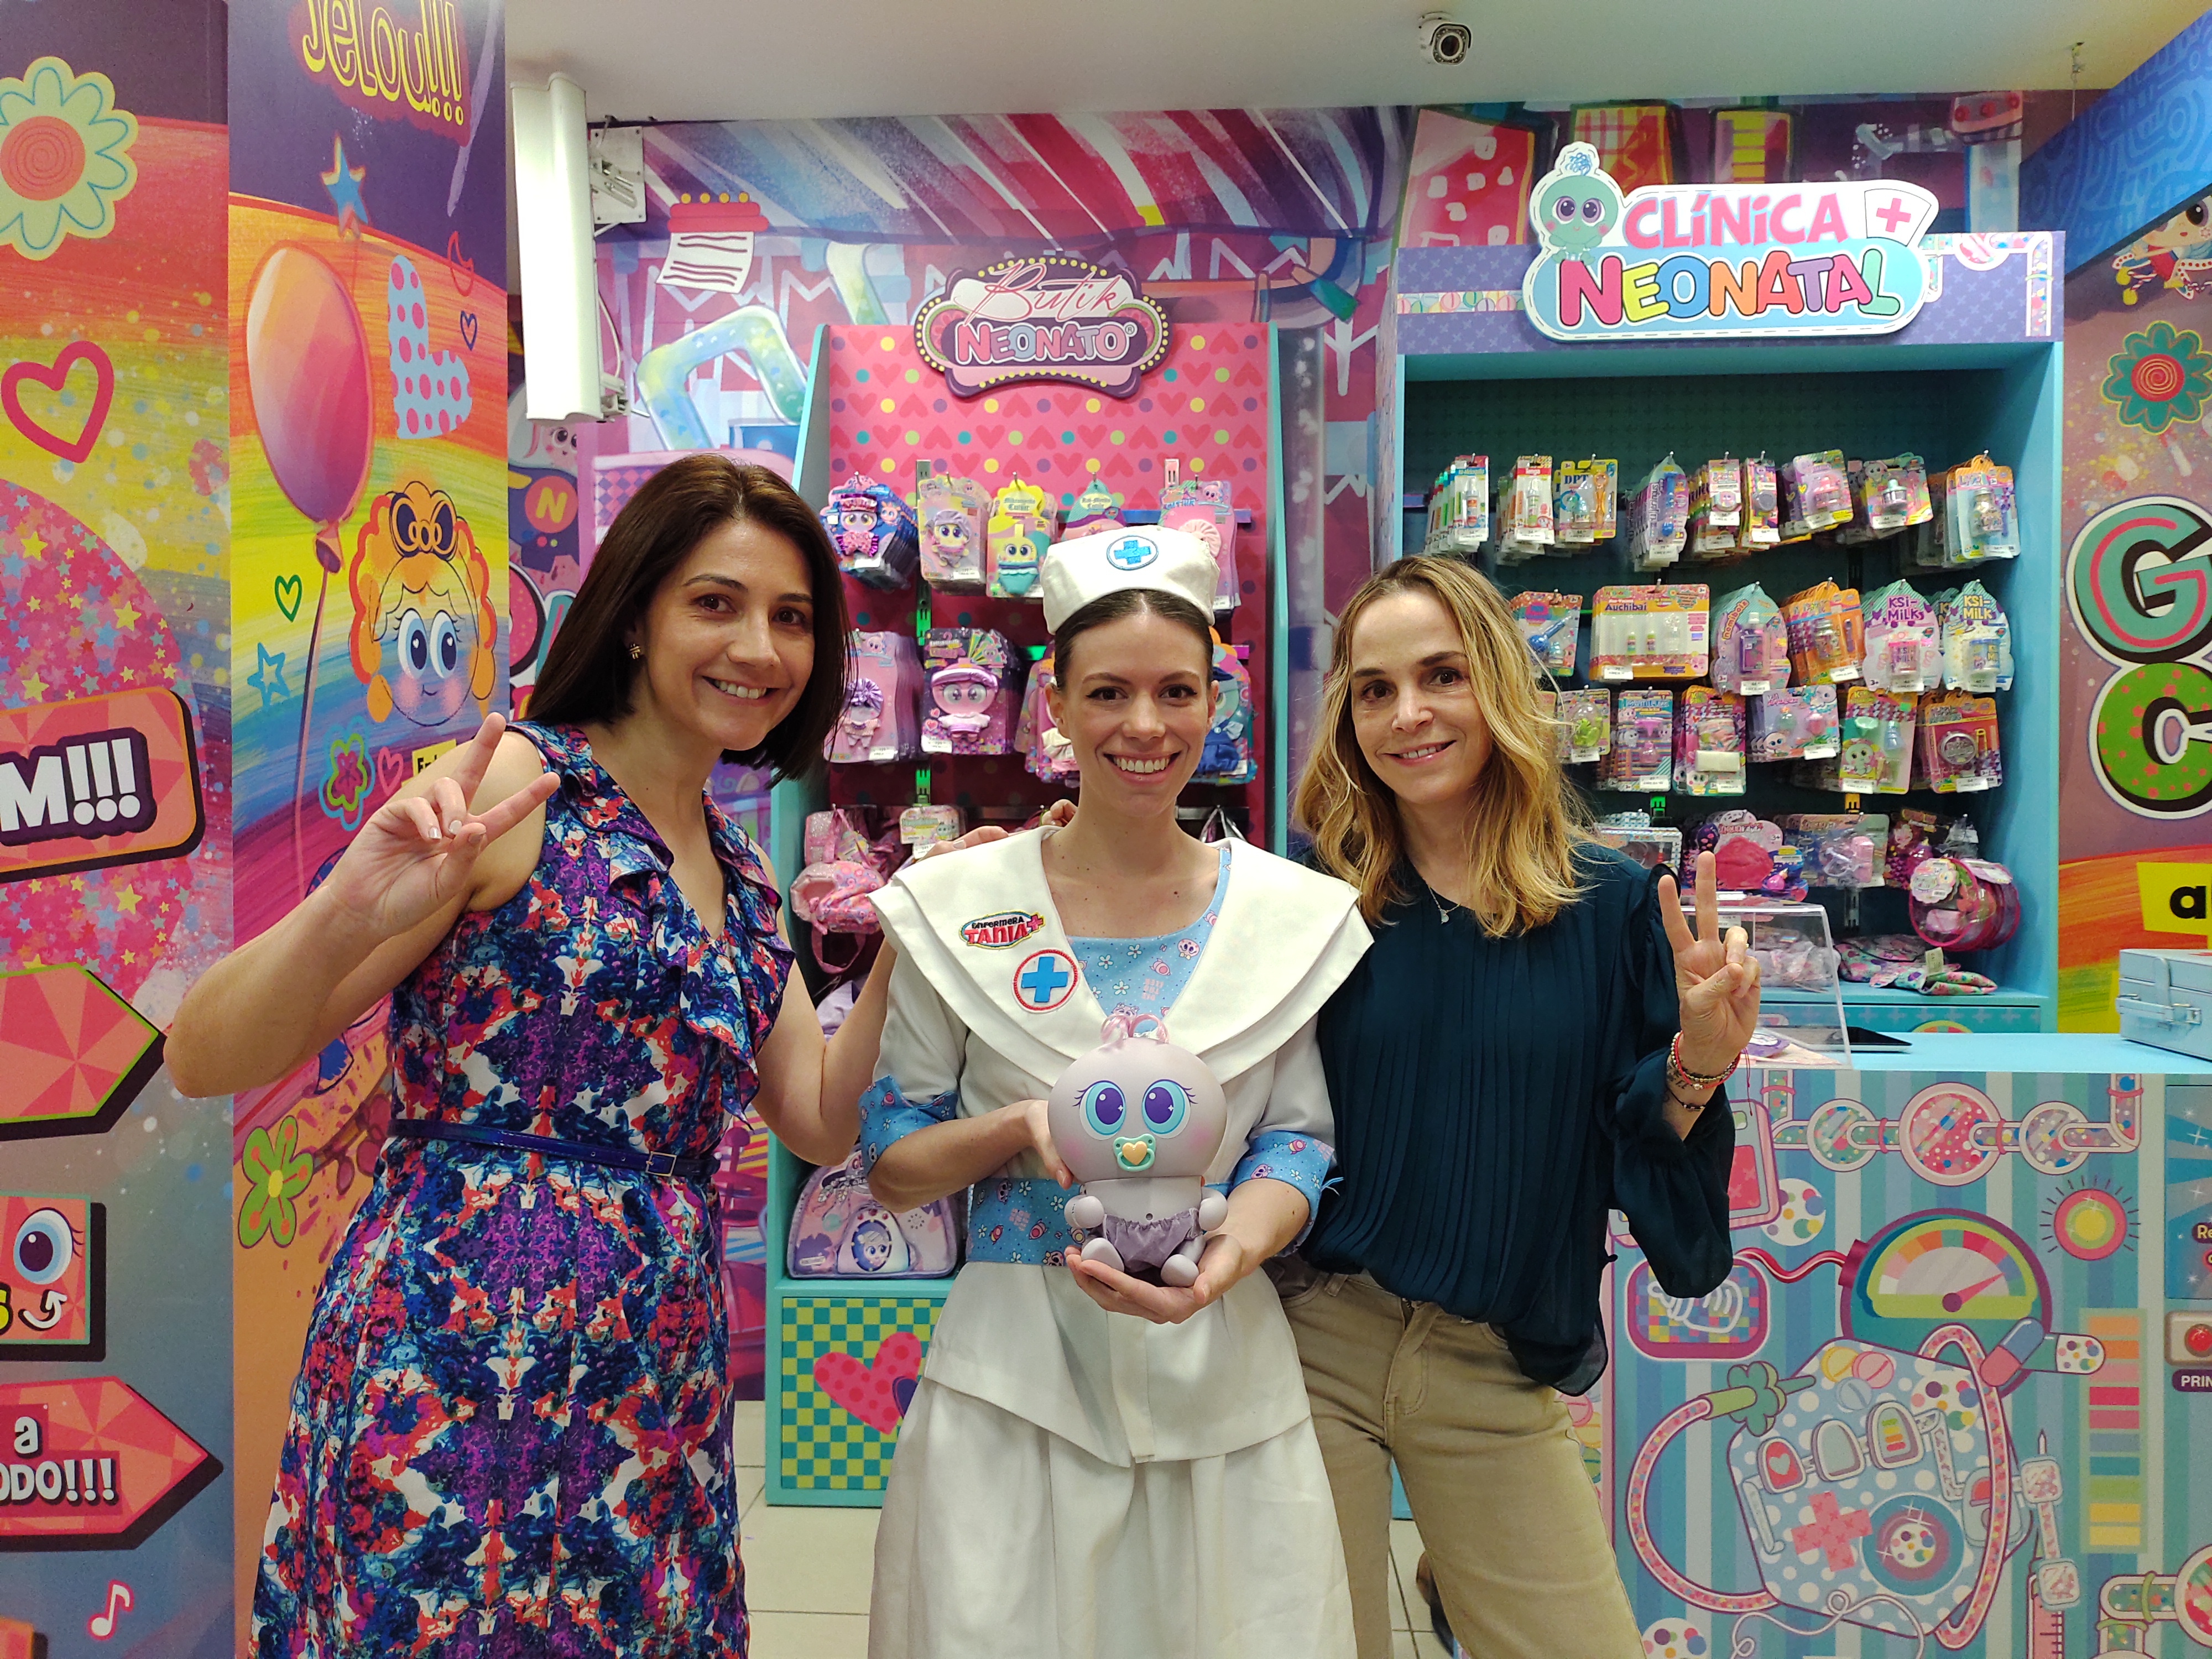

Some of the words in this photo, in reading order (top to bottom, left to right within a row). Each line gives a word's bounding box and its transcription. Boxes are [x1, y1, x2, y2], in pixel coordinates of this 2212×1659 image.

[953, 262, 1129, 327] Butik
[1558, 247, 1901, 327] NEONATAL
[956, 322, 1129, 363] NEONATO
[1564, 474, 1589, 484] DPT
[1888, 609, 1921, 621] MiLK
[1963, 607, 1992, 620] MiLK
[14, 1416, 38, 1454] a
